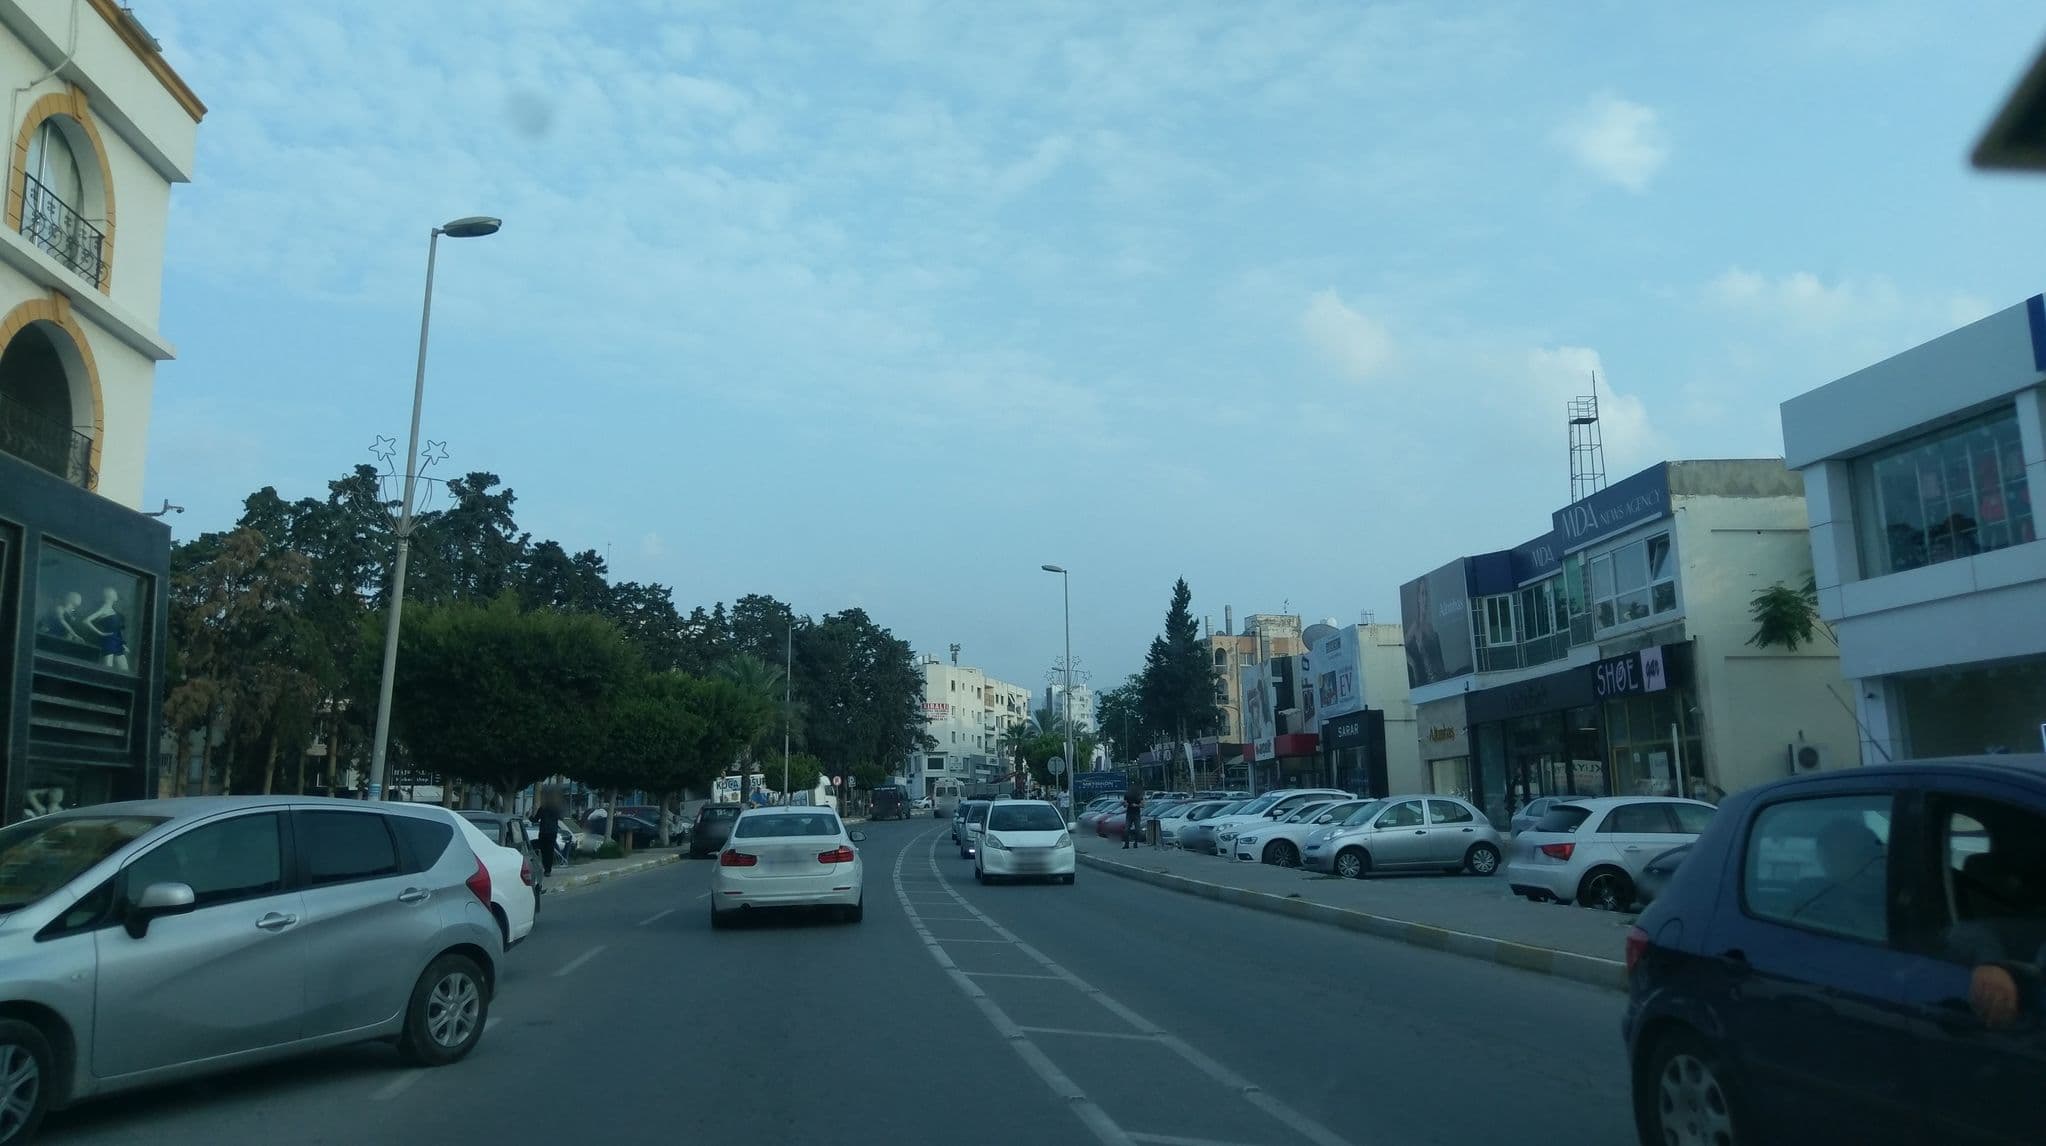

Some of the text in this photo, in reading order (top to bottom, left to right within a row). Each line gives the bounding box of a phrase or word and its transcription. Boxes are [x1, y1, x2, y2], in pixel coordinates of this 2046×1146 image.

[1600, 505, 1624, 526] NEWS
[1625, 488, 1662, 517] AGENCY
[1597, 658, 1638, 696] SHOE
[1337, 722, 1359, 737] SARAR
